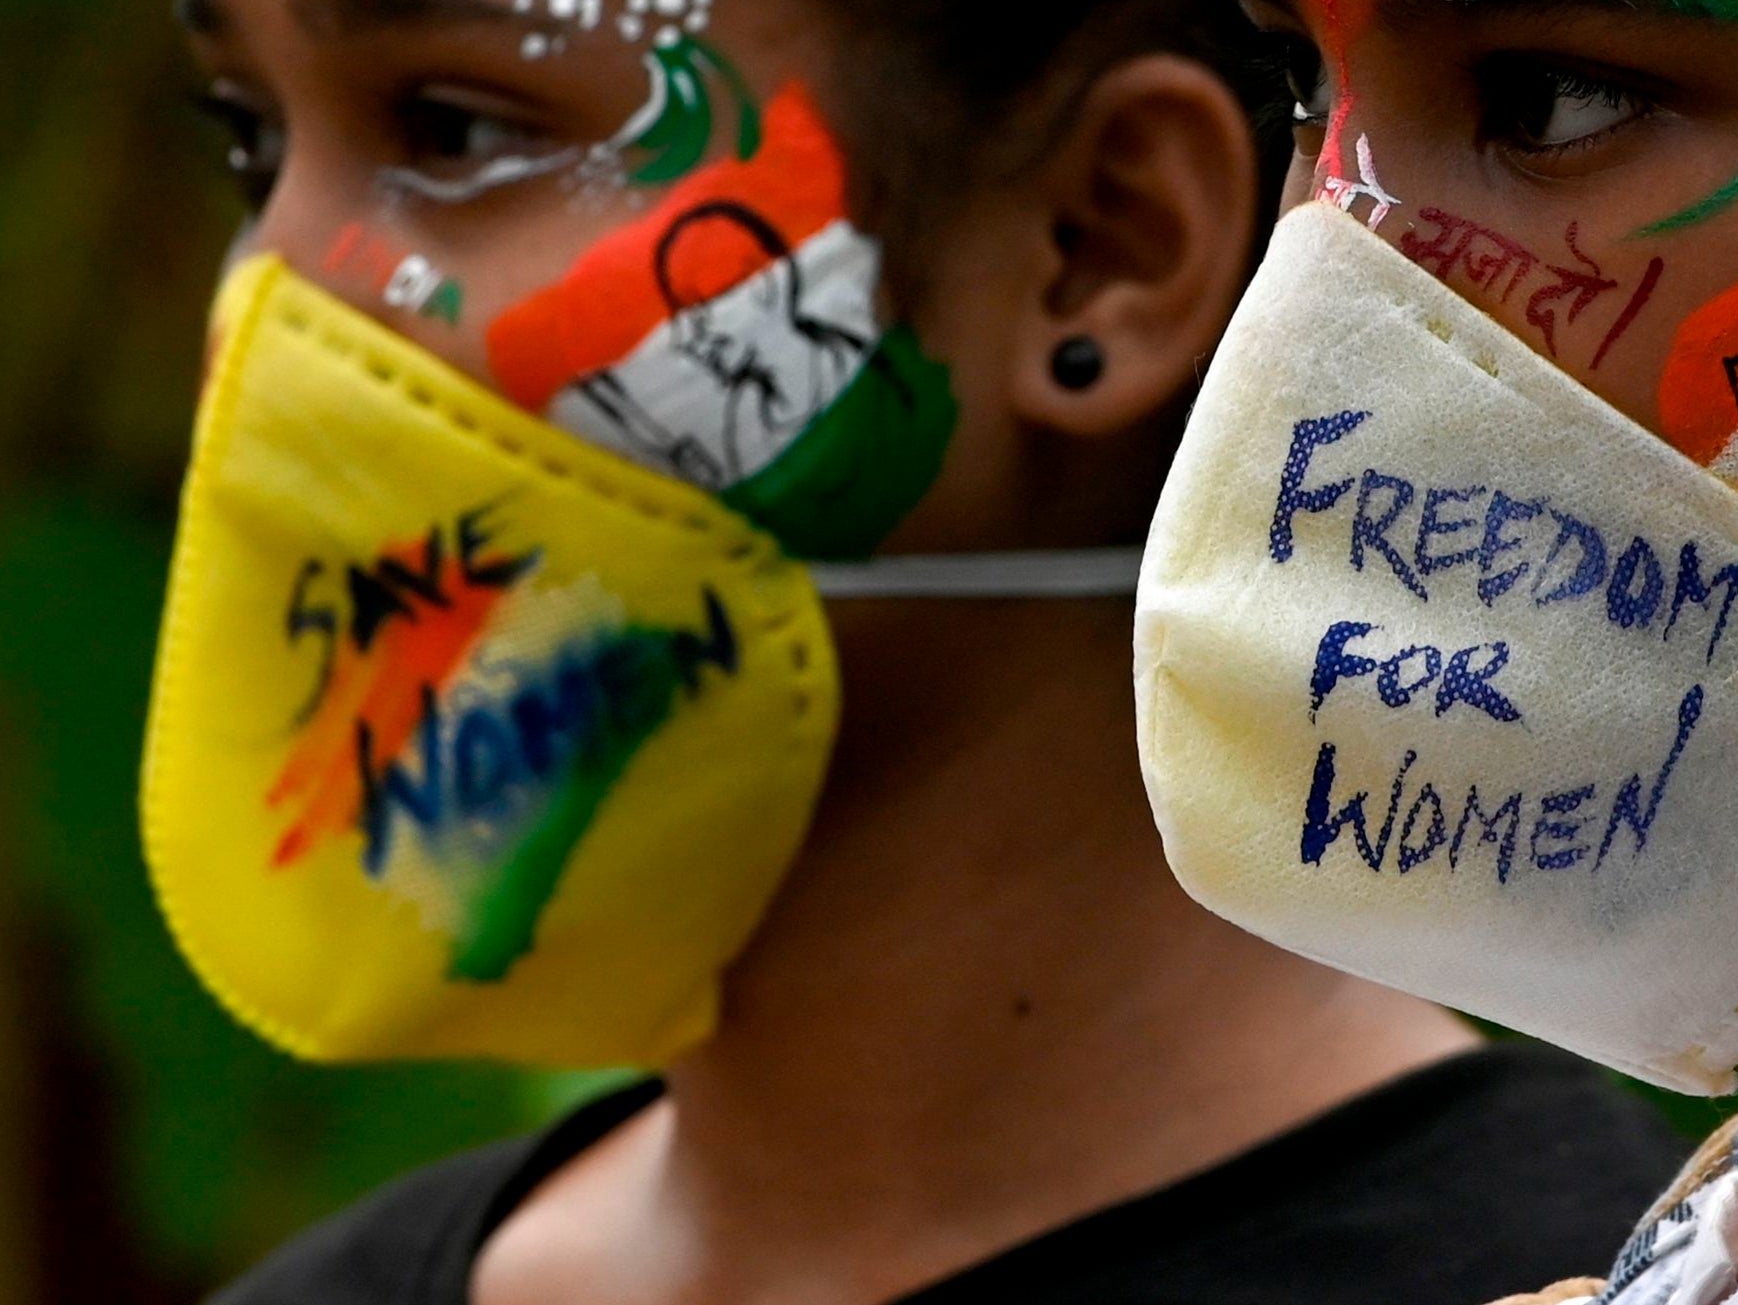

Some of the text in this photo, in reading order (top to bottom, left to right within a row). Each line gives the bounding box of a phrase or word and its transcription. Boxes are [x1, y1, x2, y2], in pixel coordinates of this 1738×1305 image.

[285, 500, 546, 732] SAVE
[1309, 620, 1524, 725] FOR
[1300, 684, 1704, 884] WOMEN
